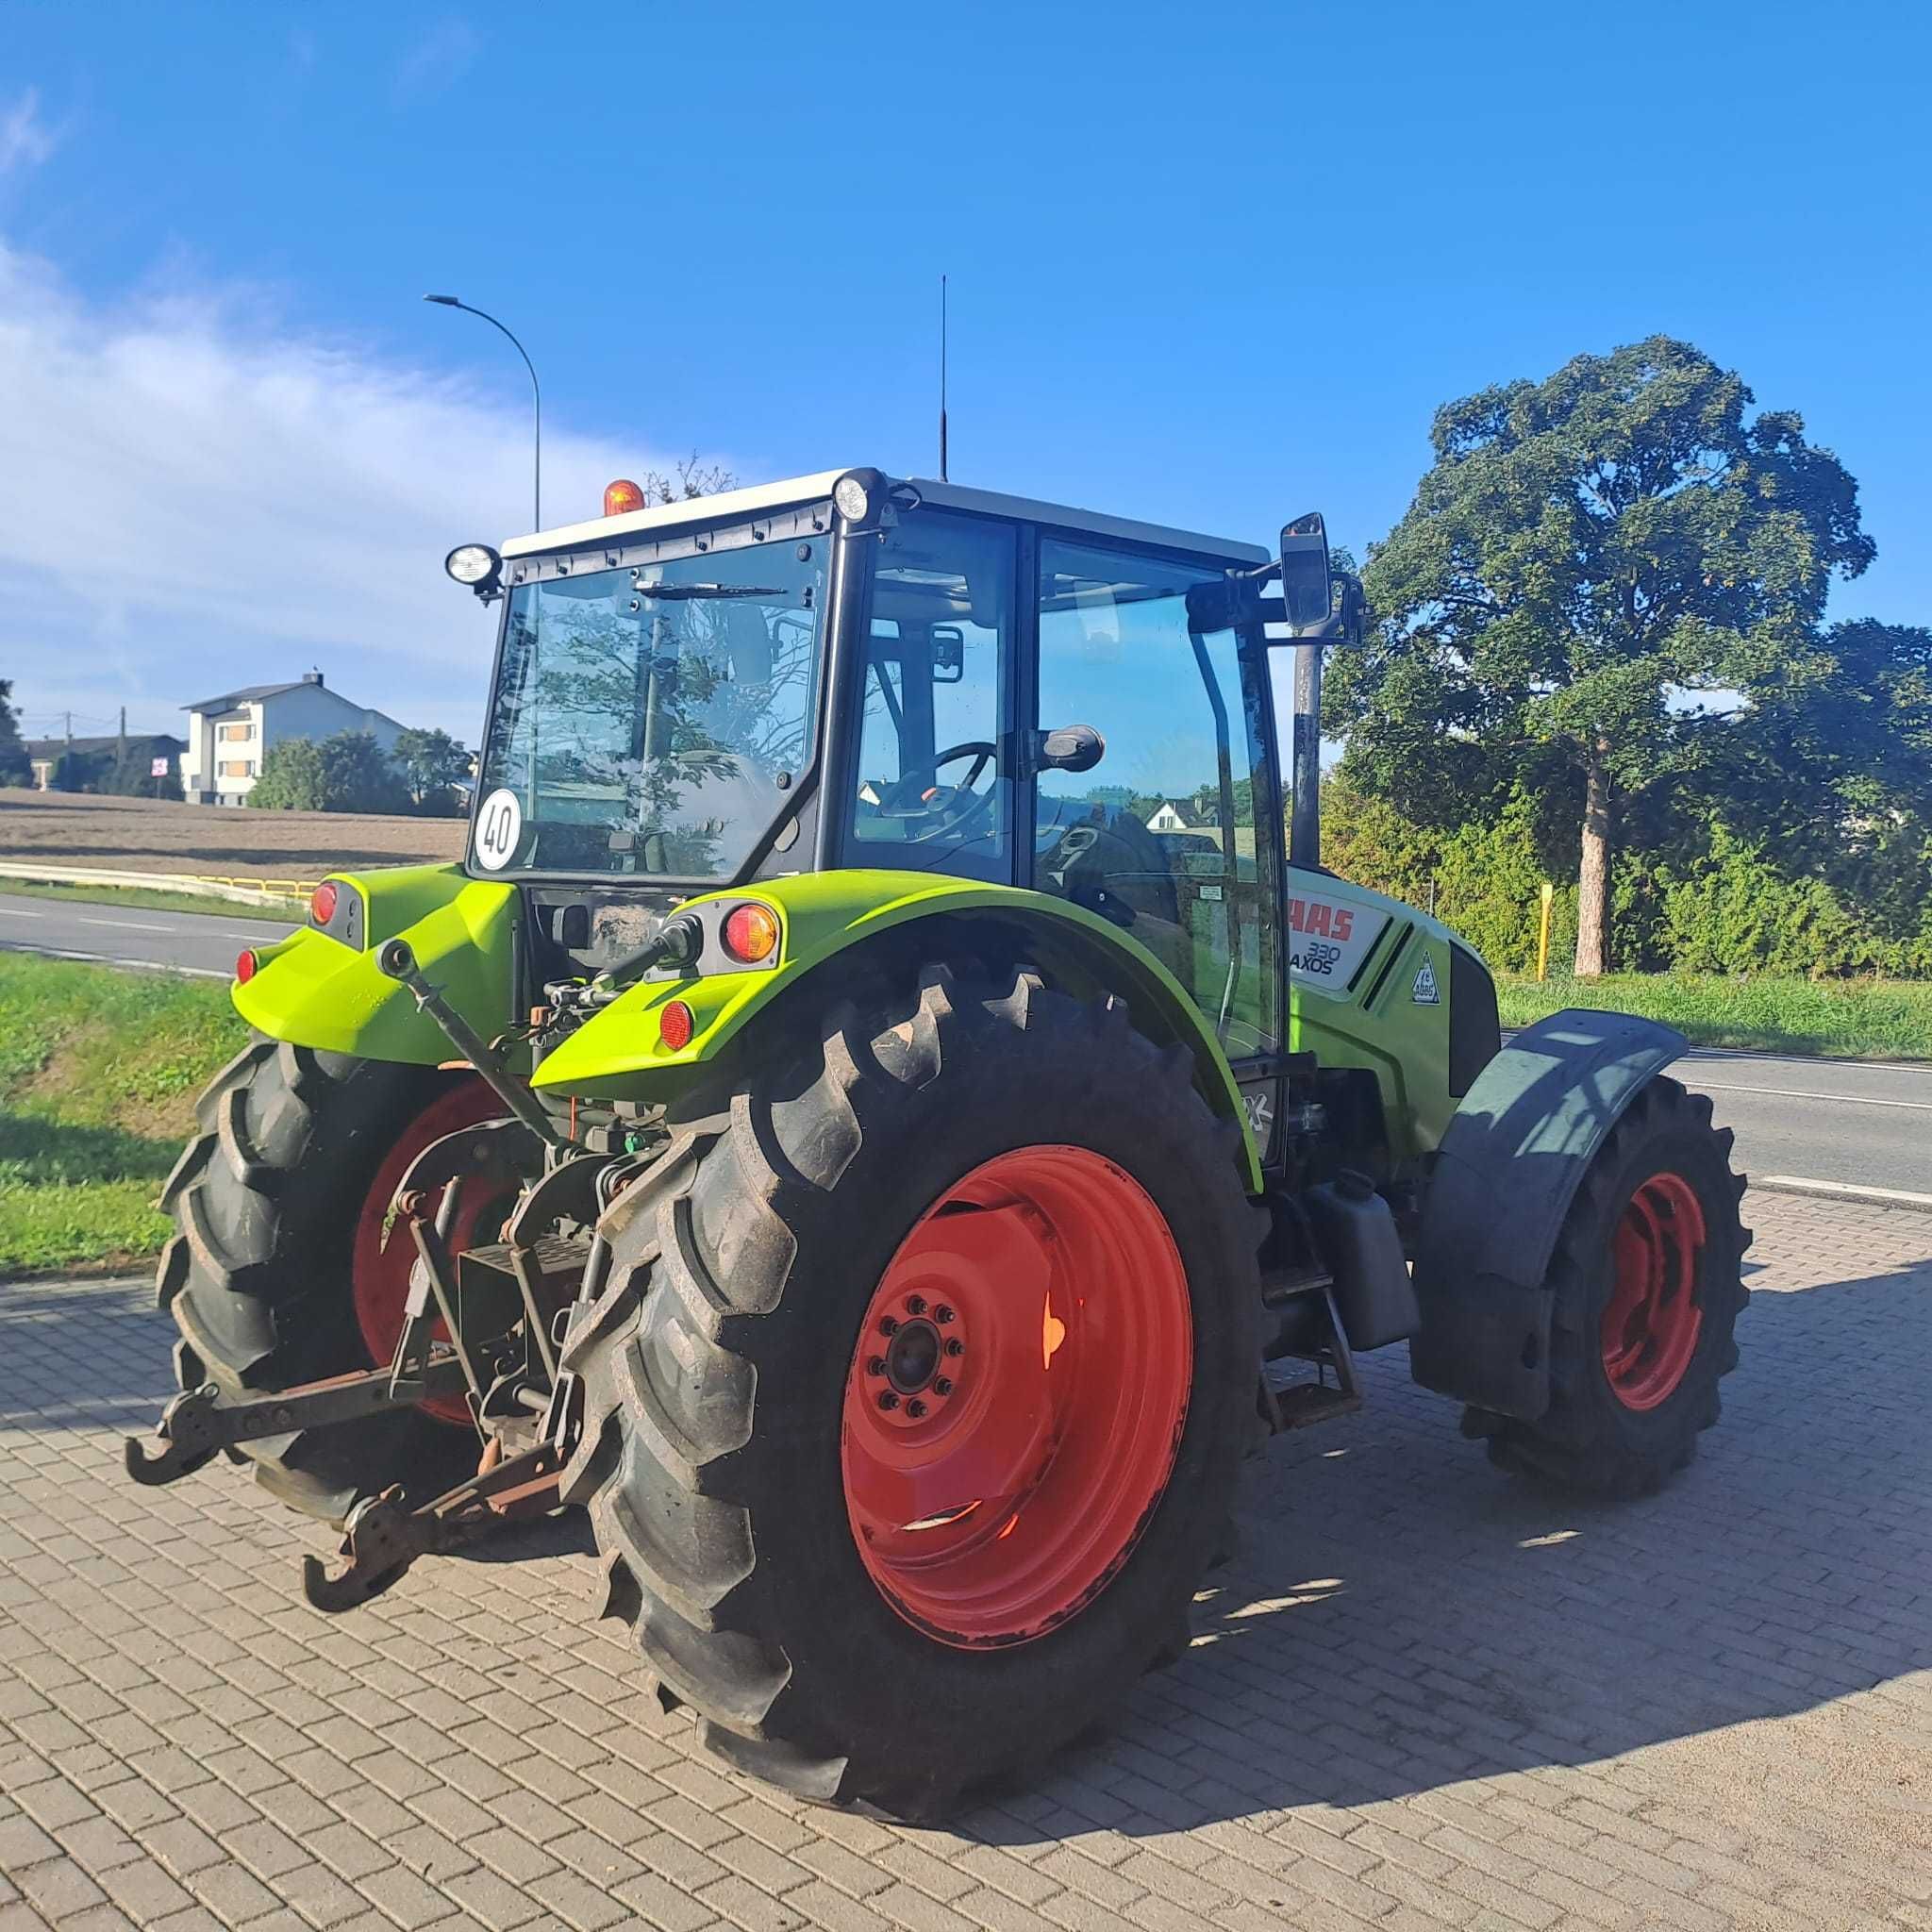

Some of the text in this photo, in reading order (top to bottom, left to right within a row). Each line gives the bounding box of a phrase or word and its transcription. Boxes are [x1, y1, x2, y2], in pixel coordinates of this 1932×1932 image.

[484, 805, 511, 855] 40
[1289, 899, 1355, 941] AAS
[1290, 954, 1335, 975] AXOS
[1307, 942, 1341, 961] 330
